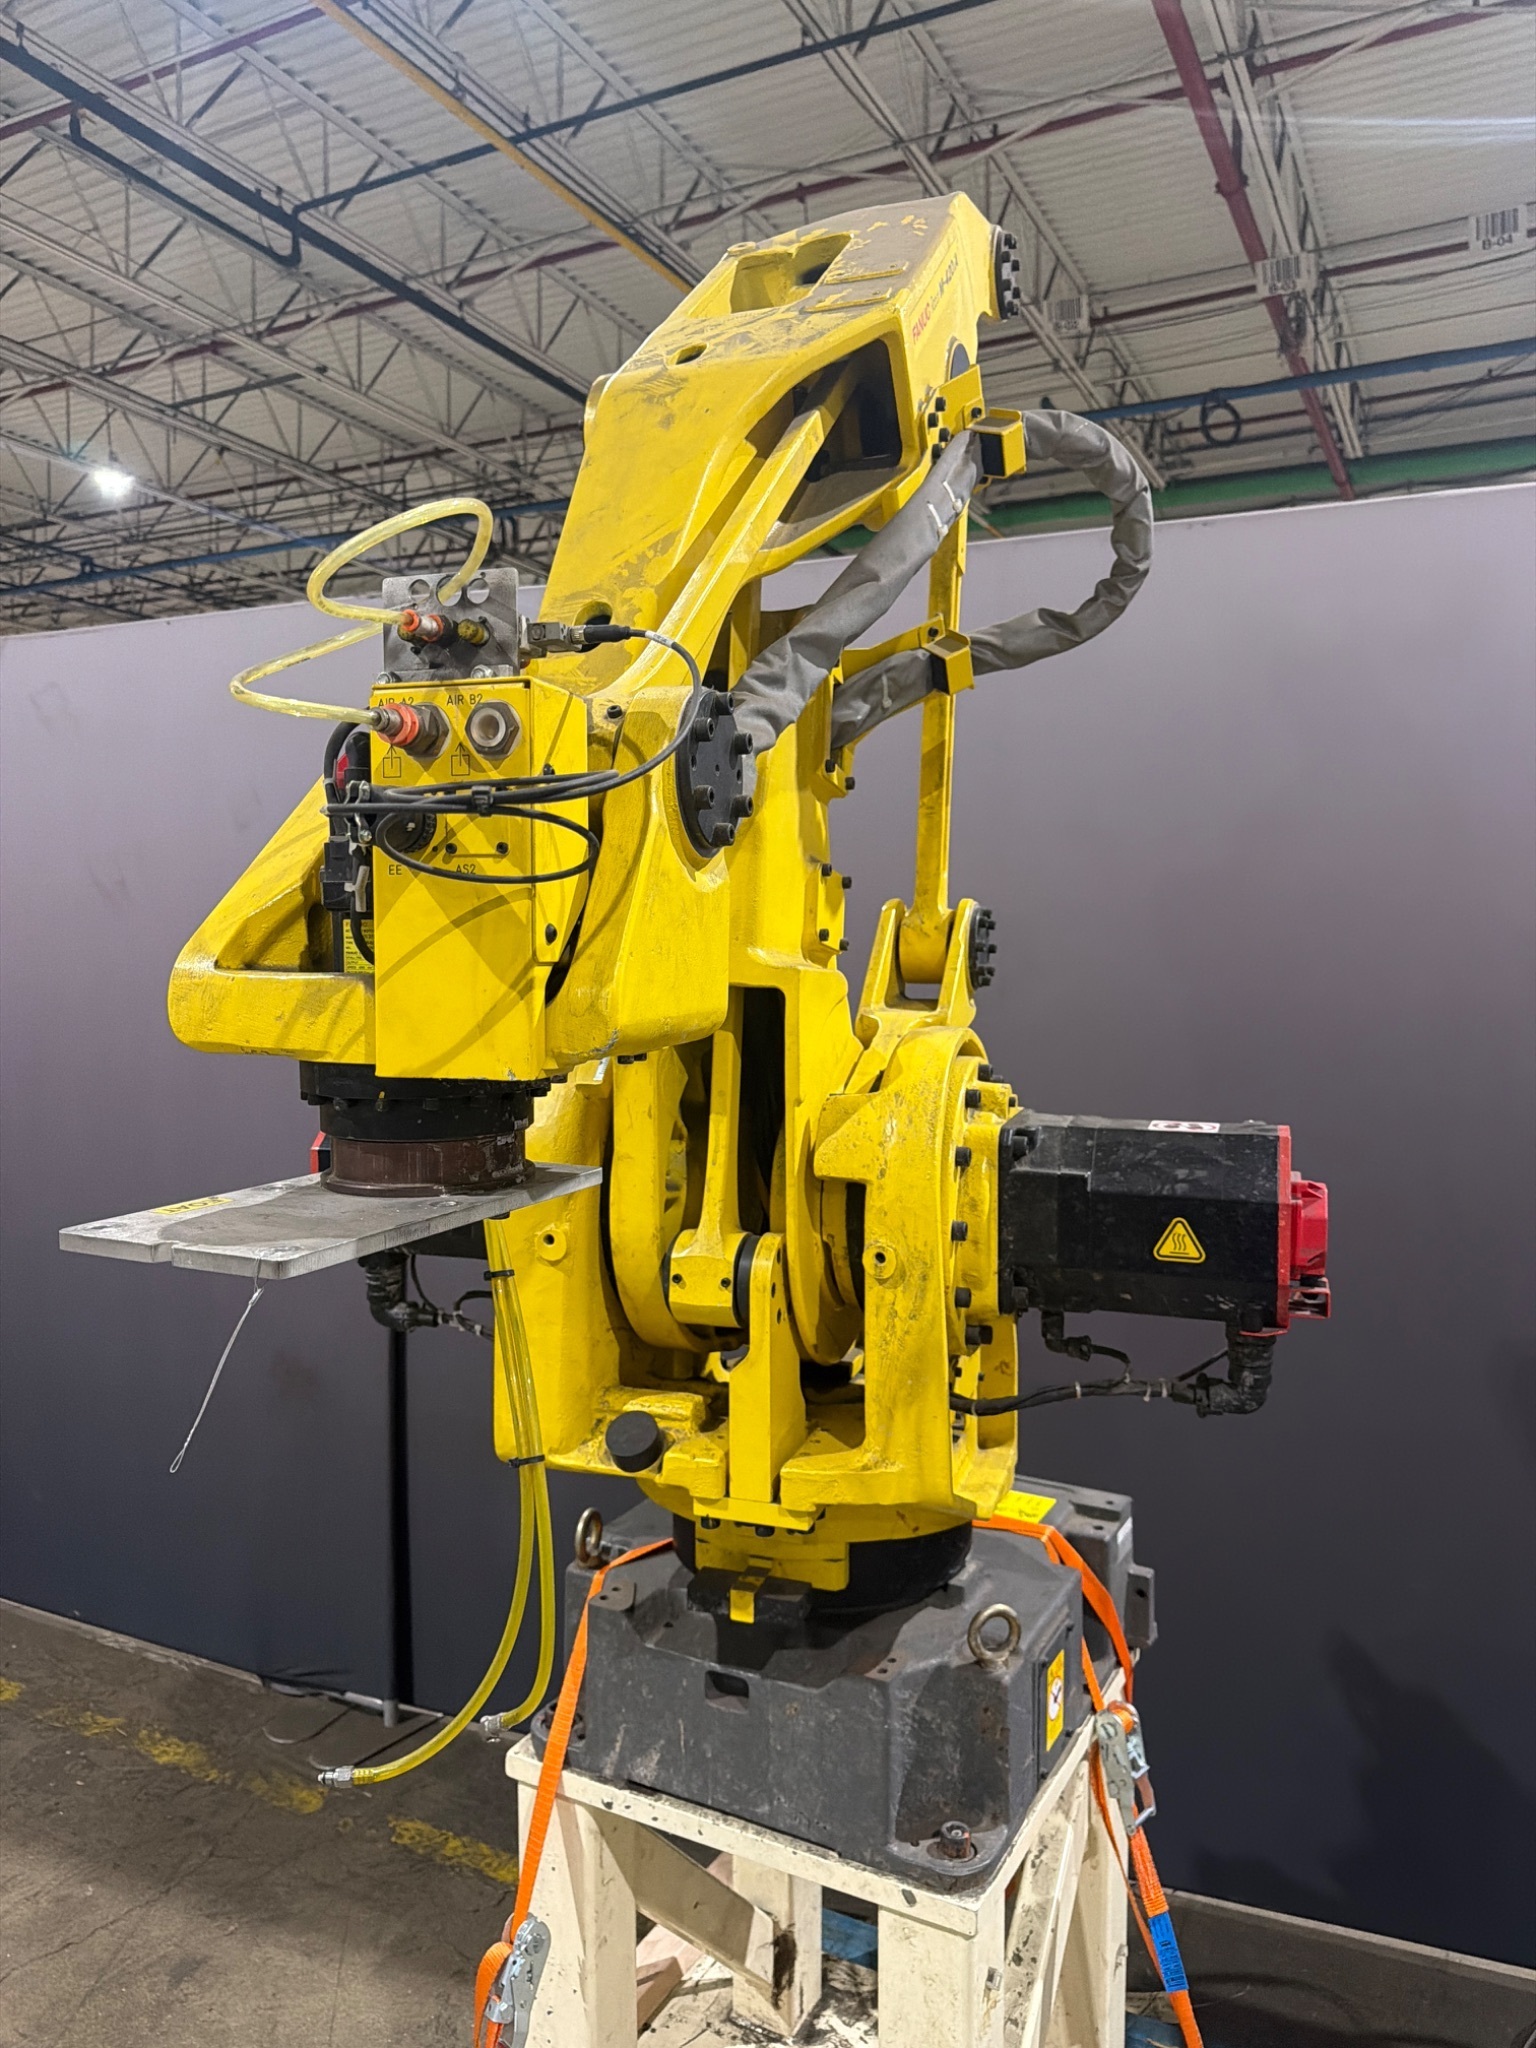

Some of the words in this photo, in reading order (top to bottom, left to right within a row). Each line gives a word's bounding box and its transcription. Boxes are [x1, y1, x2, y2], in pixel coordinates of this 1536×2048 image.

[1482, 233, 1513, 250] B-04
[912, 302, 931, 345] FANUC
[447, 694, 464, 706] AIR
[469, 693, 483, 706] B2
[388, 864, 402, 876] EE
[456, 863, 477, 875] AS2
